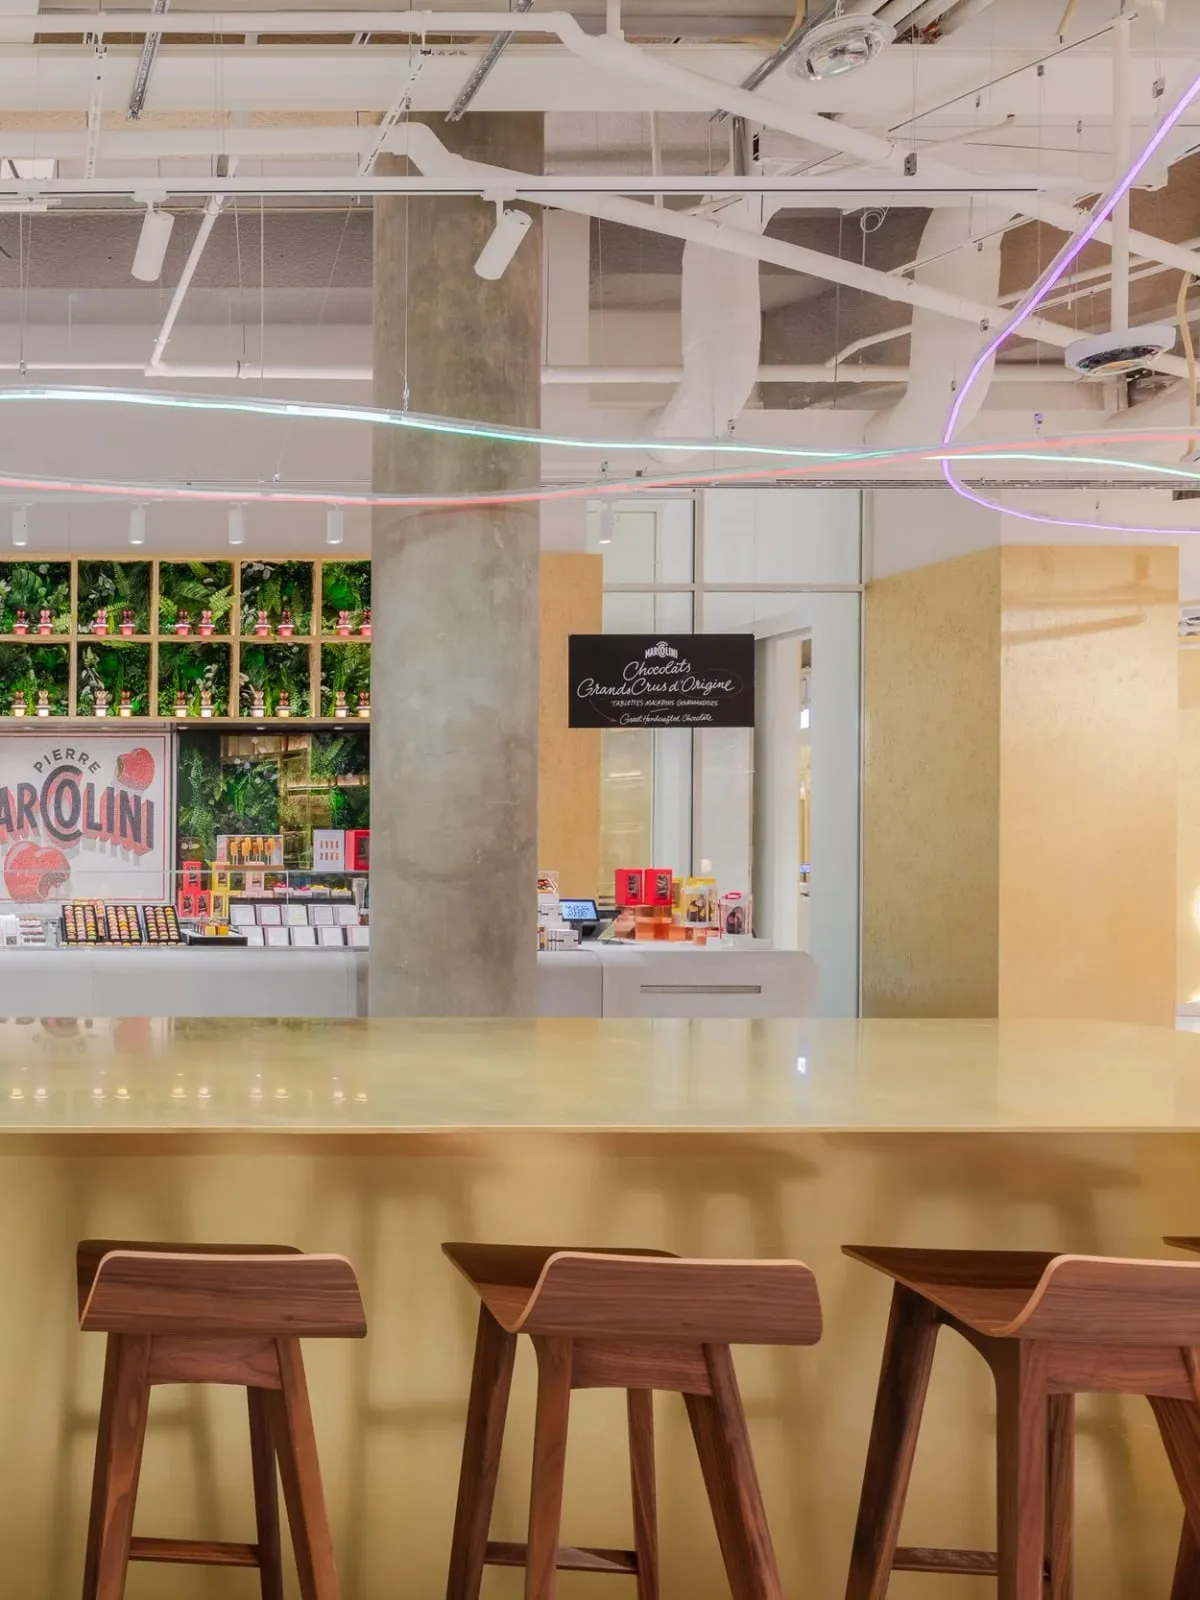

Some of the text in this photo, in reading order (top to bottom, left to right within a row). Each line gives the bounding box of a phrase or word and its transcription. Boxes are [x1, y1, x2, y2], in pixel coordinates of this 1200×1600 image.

[645, 643, 677, 659] MARCOLINI
[623, 659, 691, 681] Chocolats
[577, 676, 735, 698] Grands Crus d'Origine
[682, 713, 714, 723] Chocolate
[33, 747, 101, 774] PIERRE
